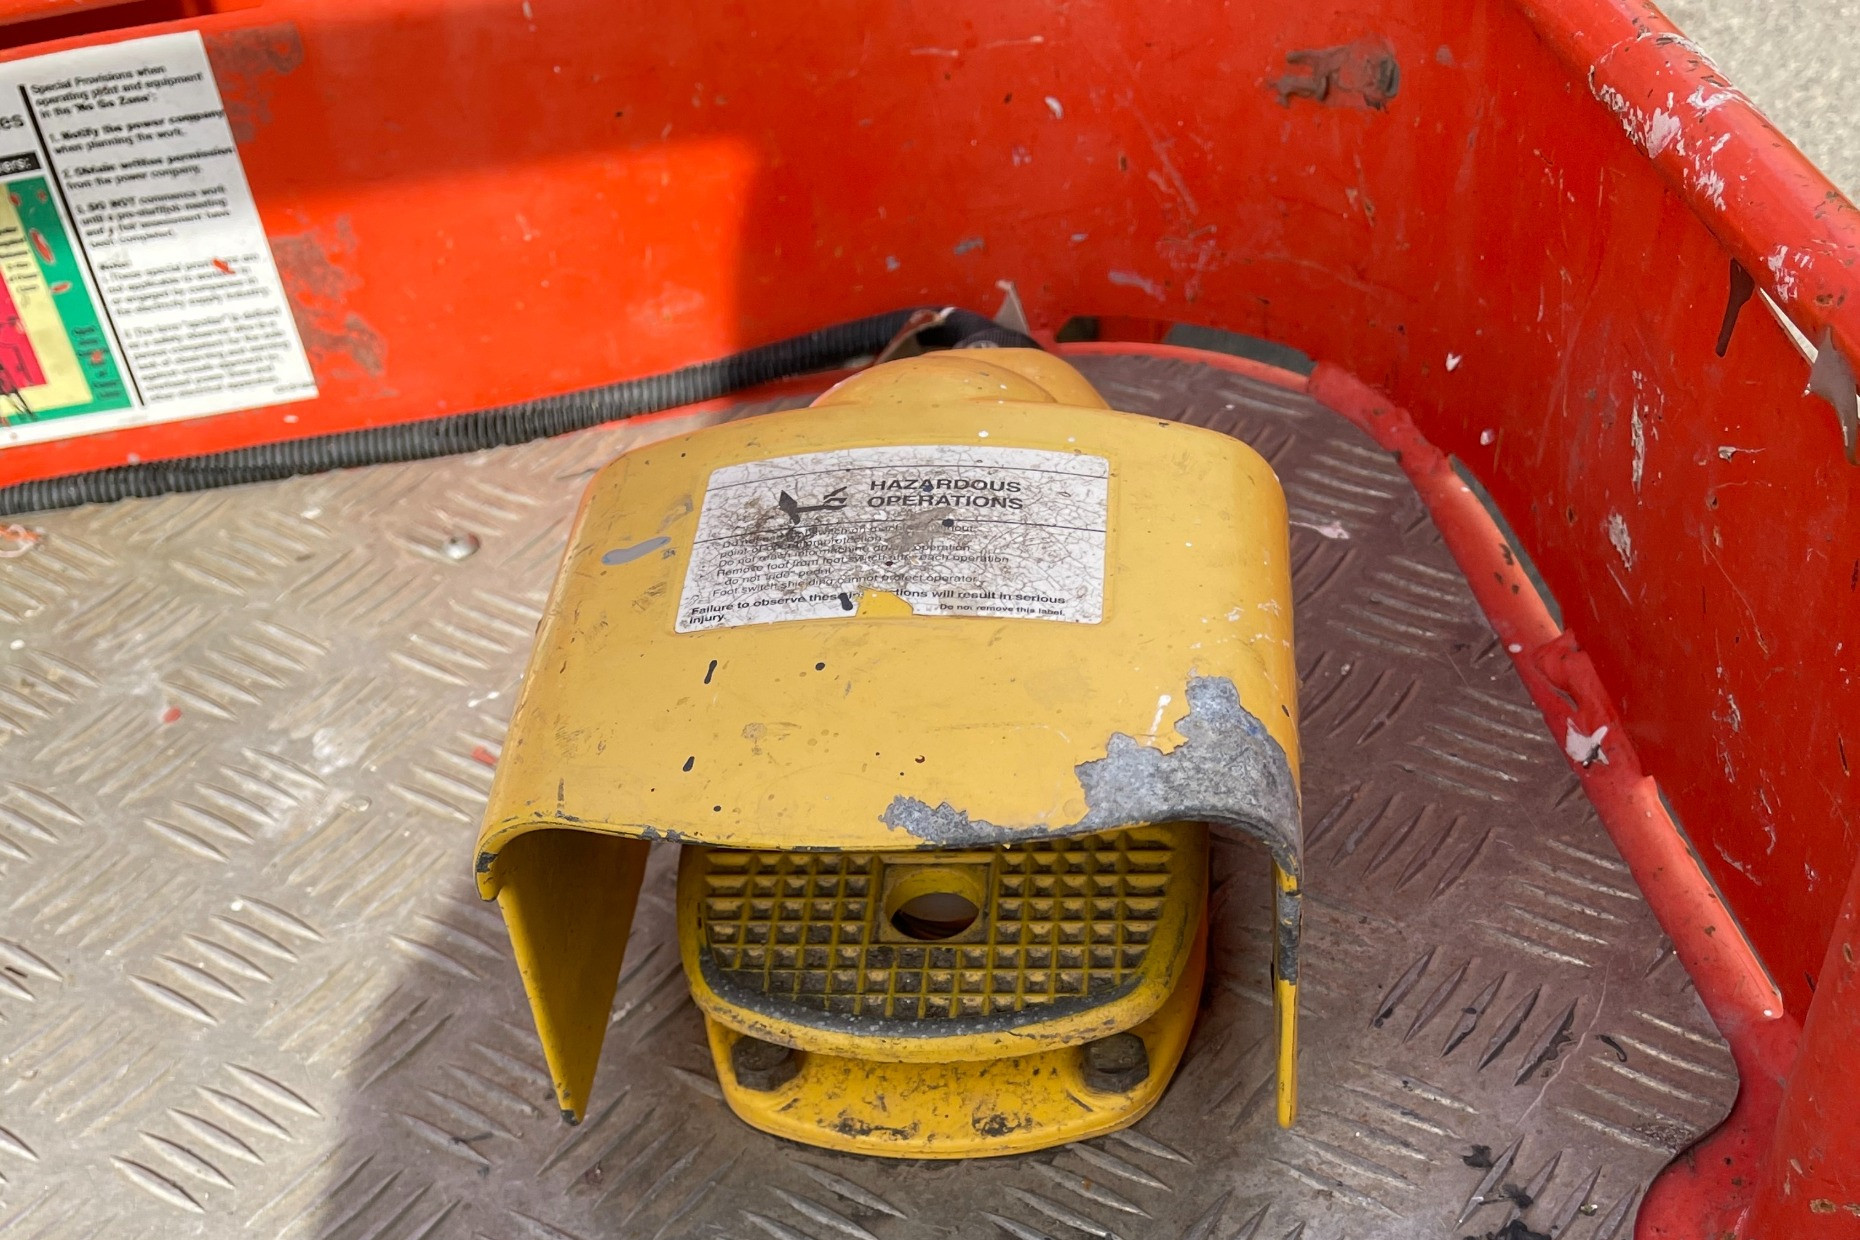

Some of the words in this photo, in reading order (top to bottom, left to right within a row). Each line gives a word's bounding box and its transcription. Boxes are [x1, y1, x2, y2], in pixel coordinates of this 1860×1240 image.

[30, 80, 72, 95] Special
[74, 72, 133, 86] Provisions
[137, 65, 166, 77] when
[36, 89, 89, 106] operating
[122, 82, 142, 93] and
[146, 72, 203, 89] equipment
[102, 123, 123, 133] the
[126, 118, 164, 132] power
[54, 143, 82, 154] when
[86, 135, 134, 151] planning
[66, 178, 92, 191] from
[114, 172, 148, 185] power
[870, 479, 1021, 493] HAZARDOUS
[867, 496, 1023, 510] OPERATIONS
[716, 565, 764, 577] Remove
[767, 559, 789, 570] foot
[953, 554, 1009, 563] operation
[719, 559, 734, 567] Do
[742, 575, 760, 583] not
[712, 587, 739, 597] Foot
[742, 582, 777, 594] switch
[691, 604, 734, 616] Failure
[753, 596, 806, 607] observe
[809, 593, 843, 602] thes
[931, 590, 954, 599] will
[957, 591, 996, 600] result
[1000, 592, 1012, 601] in
[1015, 595, 1066, 604] serious
[1016, 605, 1035, 614] this
[1038, 608, 1066, 616] label.
